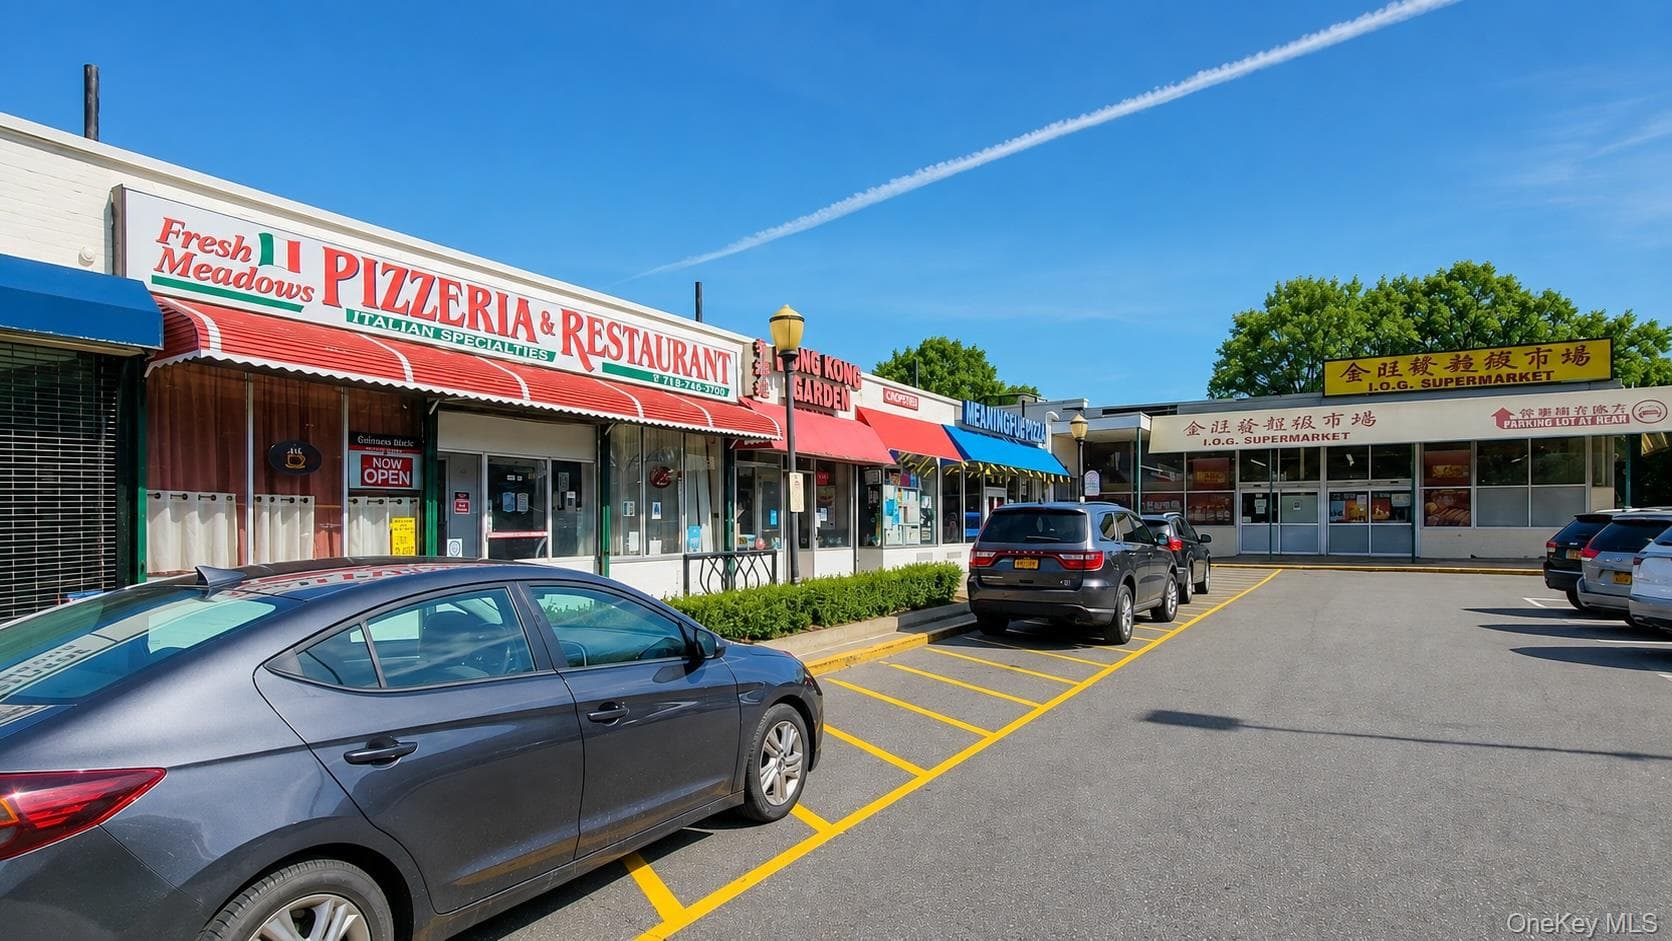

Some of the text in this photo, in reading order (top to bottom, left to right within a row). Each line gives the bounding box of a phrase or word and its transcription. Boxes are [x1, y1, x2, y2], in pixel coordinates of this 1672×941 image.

[155, 216, 252, 262] Fresh
[153, 246, 315, 302] Meadows
[322, 246, 538, 343] PIZZERIA
[540, 310, 556, 337] &
[560, 308, 731, 385] RESTAURANT
[352, 310, 549, 361] ITALIAN SPECIALTIES
[825, 355, 862, 390] KONG
[1368, 370, 1555, 392] I.O.G. SUPERMARKET
[793, 375, 850, 412] GARDEN
[1203, 432, 1351, 446] I.O.G. SUPERMARKET
[1503, 418, 1552, 429] PARKING
[1555, 417, 1576, 427] LOT
[1578, 416, 1592, 425] AT
[364, 468, 411, 486] OPEN
[372, 457, 403, 469] NOW
